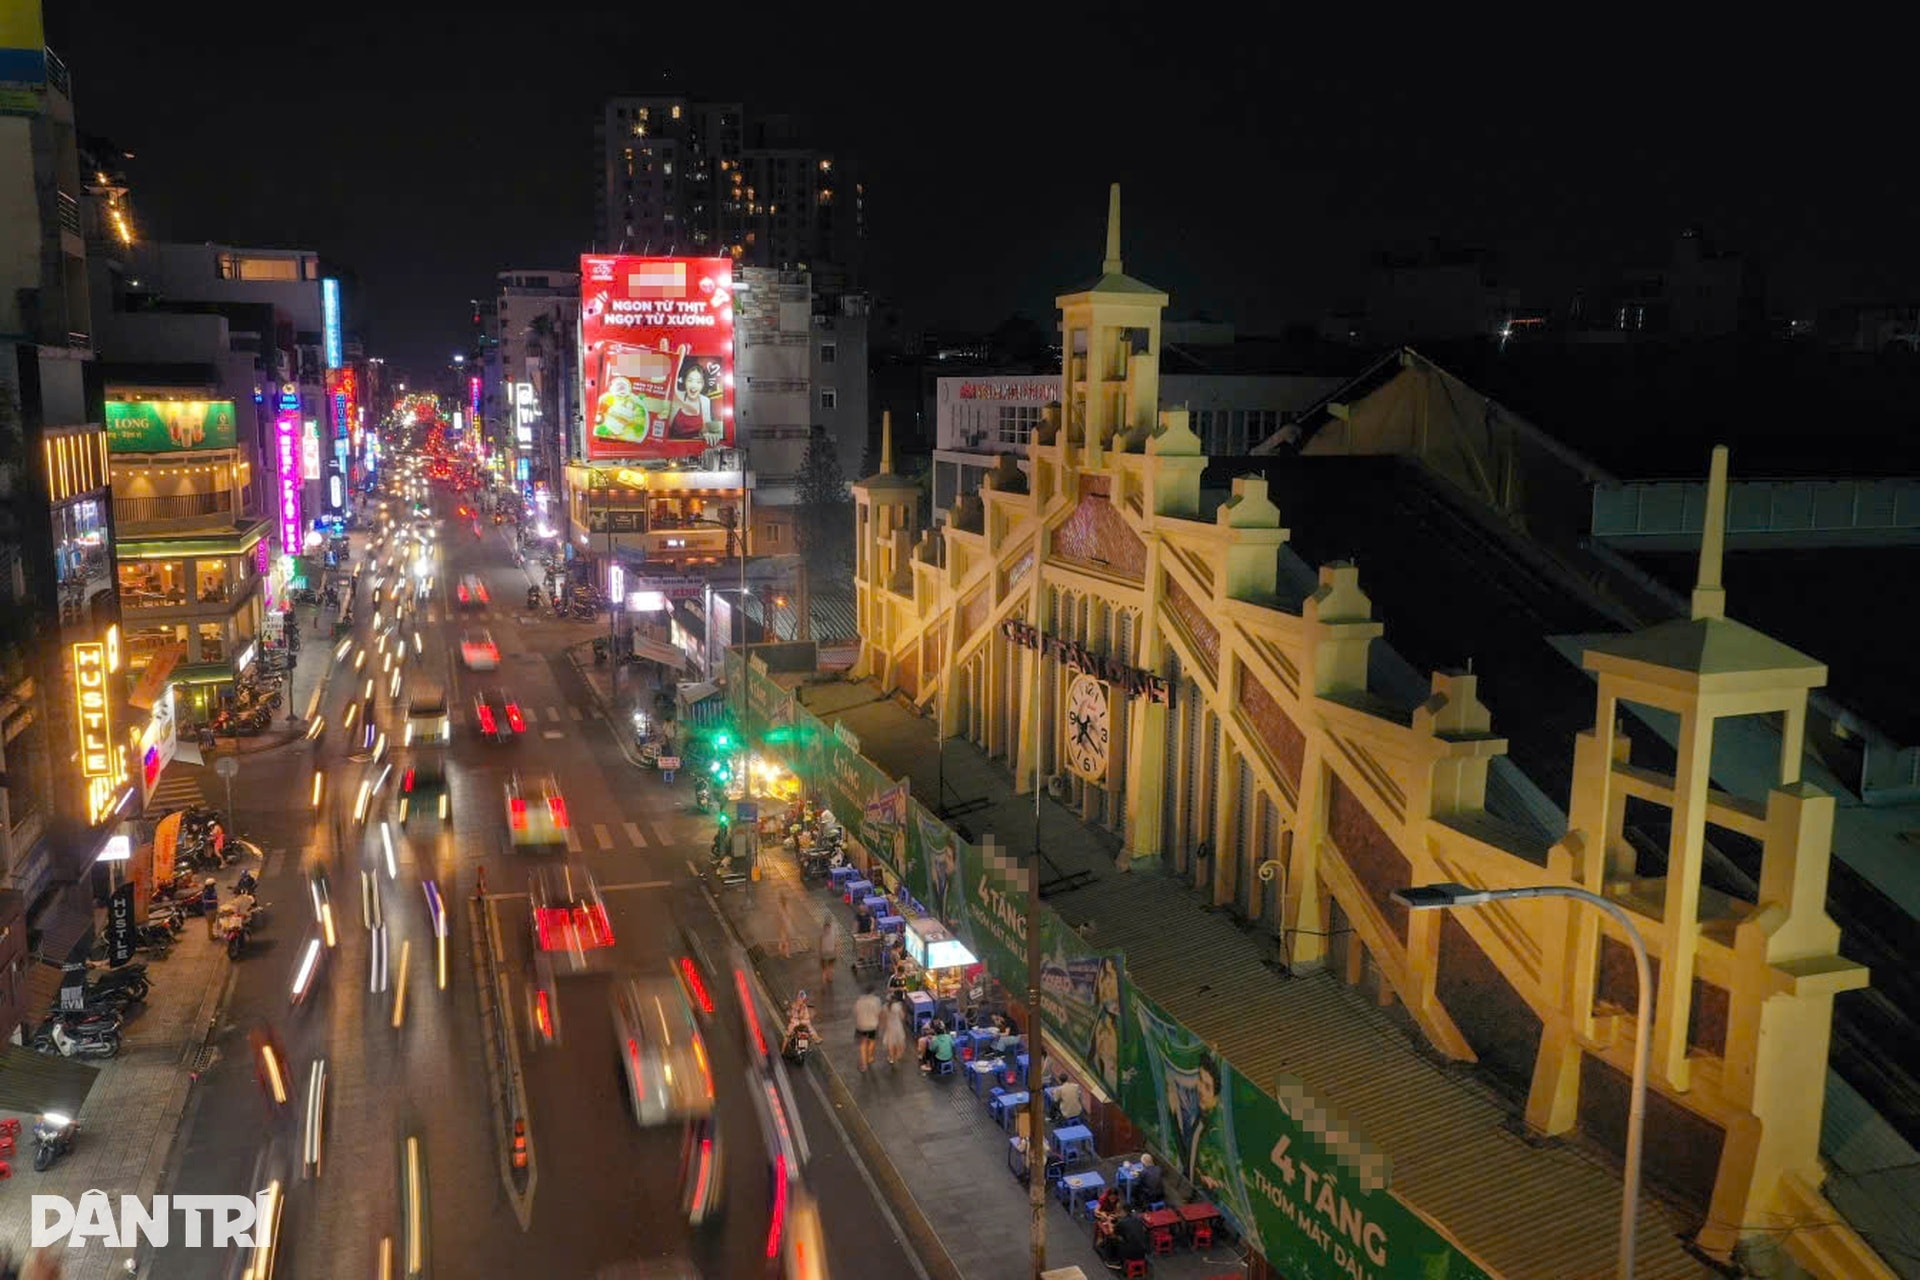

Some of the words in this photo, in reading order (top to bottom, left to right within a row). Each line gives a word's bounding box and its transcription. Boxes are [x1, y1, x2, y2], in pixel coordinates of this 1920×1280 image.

[604, 313, 642, 327] NGỌT
[645, 312, 664, 325] TỪ
[667, 313, 715, 325] XƯƠNG
[612, 301, 652, 311] NGON
[654, 299, 674, 311] TỪ
[677, 301, 706, 314] THỊT
[115, 418, 149, 429] LONG
[79, 650, 107, 770] HUSTLE
[978, 874, 990, 908] 4
[113, 898, 128, 960] HUSTLE
[1253, 1167, 1296, 1221] THƠM
[1297, 1209, 1332, 1256] MÁT
[1271, 1134, 1295, 1185] 4
[1300, 1162, 1388, 1266] TẦNG
